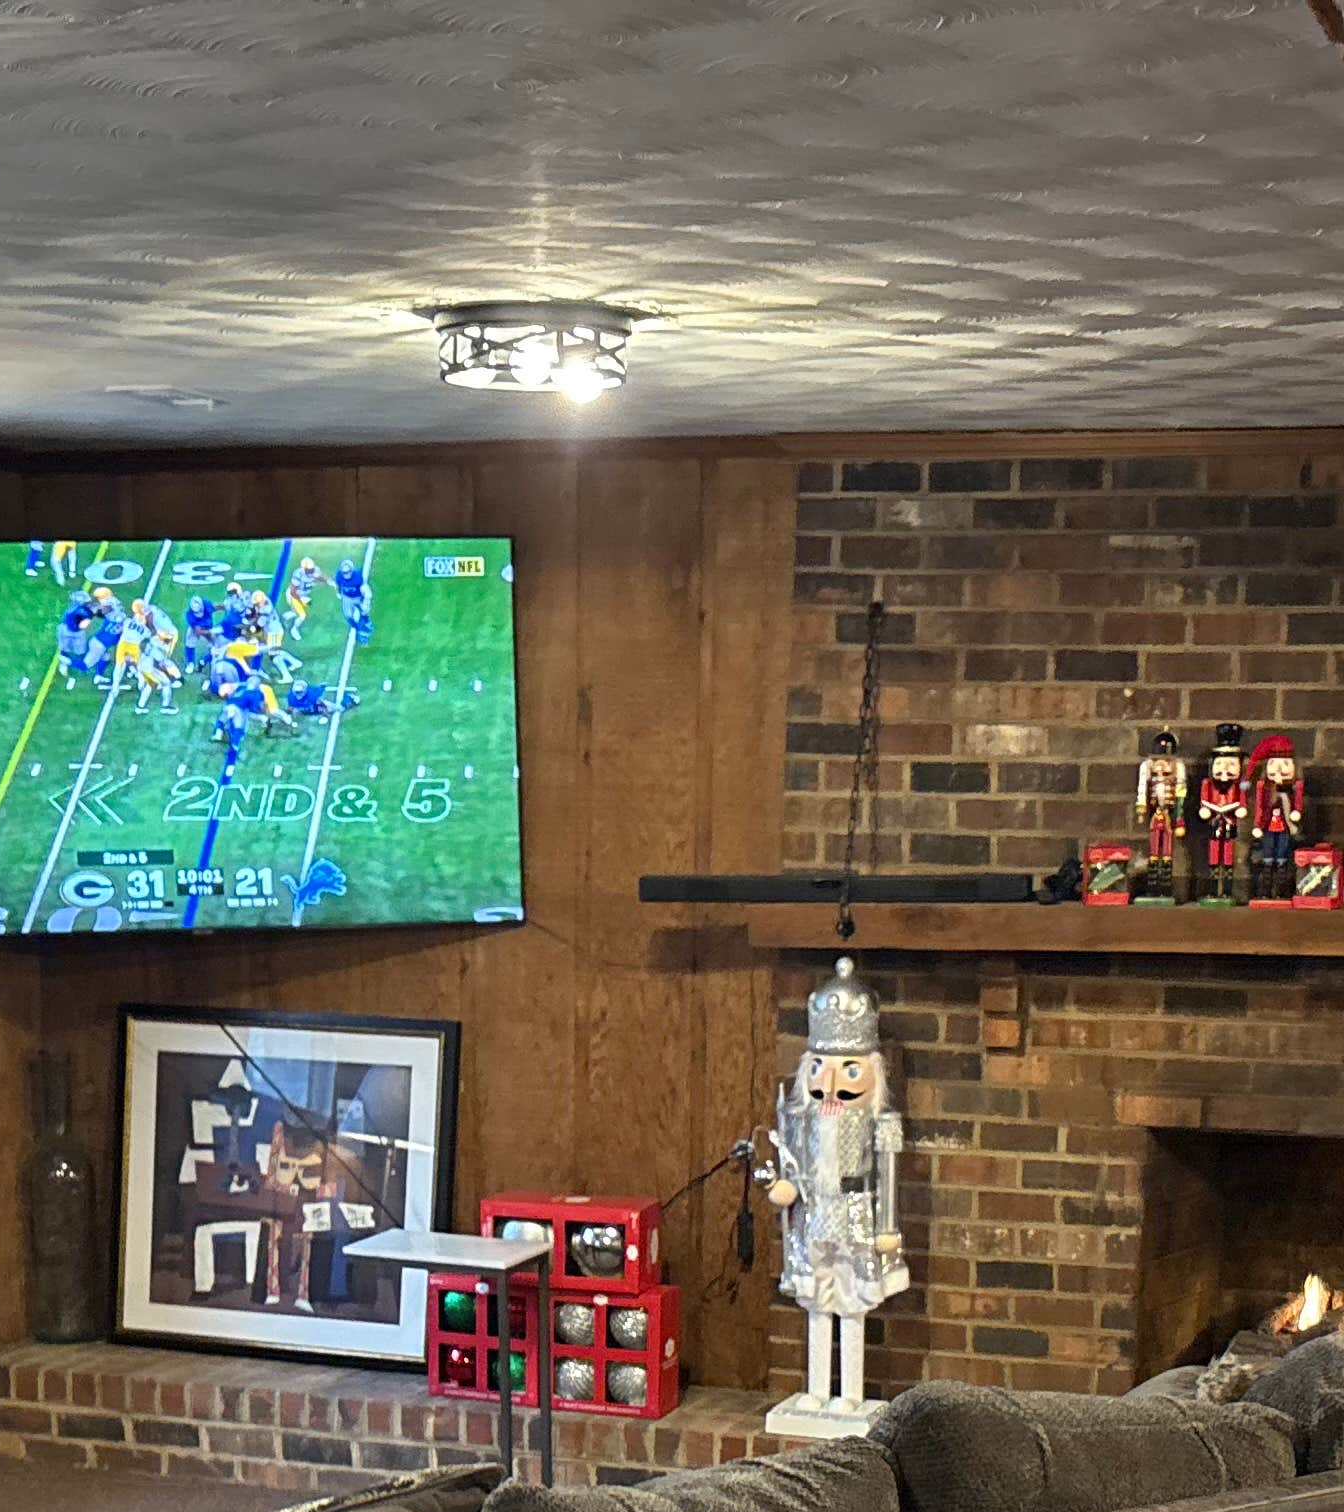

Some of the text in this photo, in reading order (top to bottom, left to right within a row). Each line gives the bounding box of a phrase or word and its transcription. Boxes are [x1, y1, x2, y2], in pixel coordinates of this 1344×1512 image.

[426, 560, 481, 575] FOX NFL
[163, 776, 452, 823] 2ND & 5
[127, 869, 165, 898] 31
[177, 869, 224, 885] 10:01
[235, 867, 273, 896] 21
